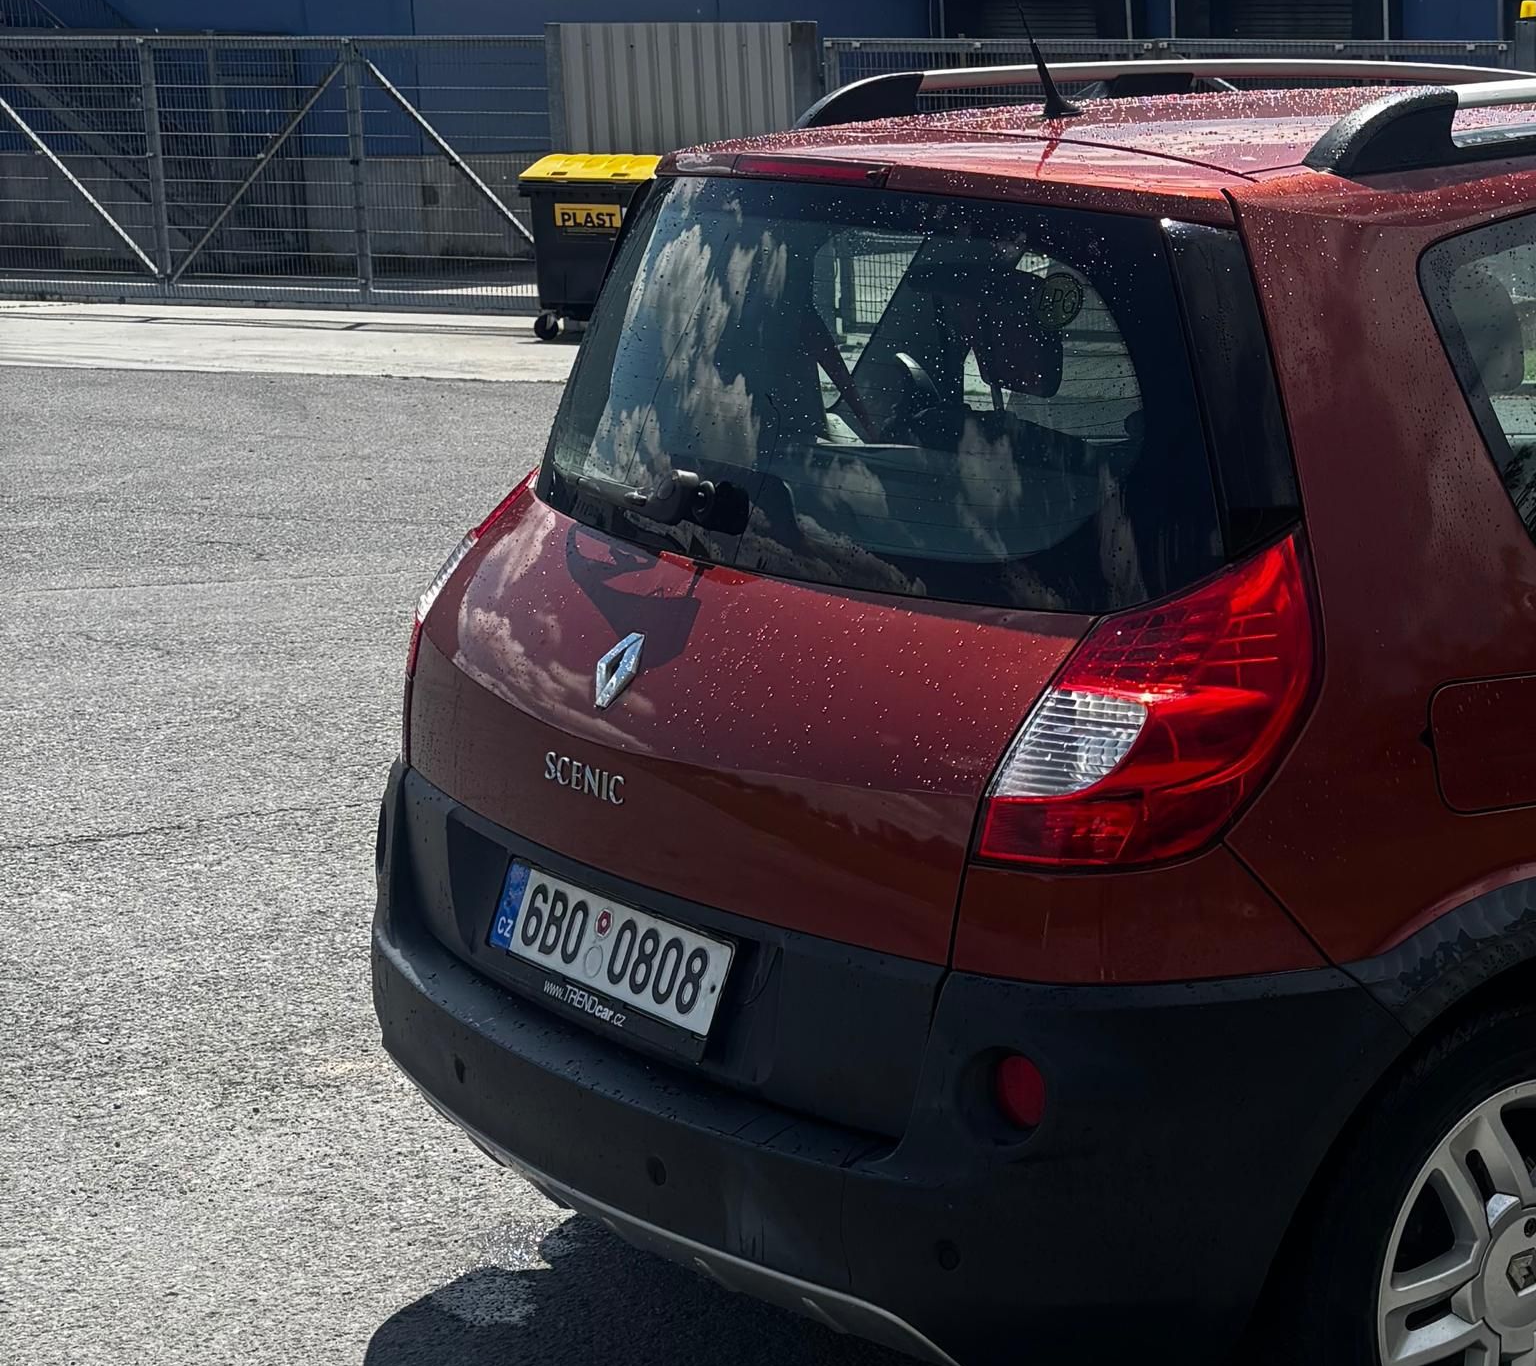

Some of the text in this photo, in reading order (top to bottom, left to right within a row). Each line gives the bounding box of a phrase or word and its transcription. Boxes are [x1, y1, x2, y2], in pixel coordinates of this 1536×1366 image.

[560, 211, 616, 228] PLAST
[1038, 286, 1078, 315] LPG
[544, 751, 625, 805] SCENIC
[497, 915, 514, 938] CZ
[607, 919, 708, 1014] 0808
[543, 980, 626, 1027] www.TRENDcar.cz
